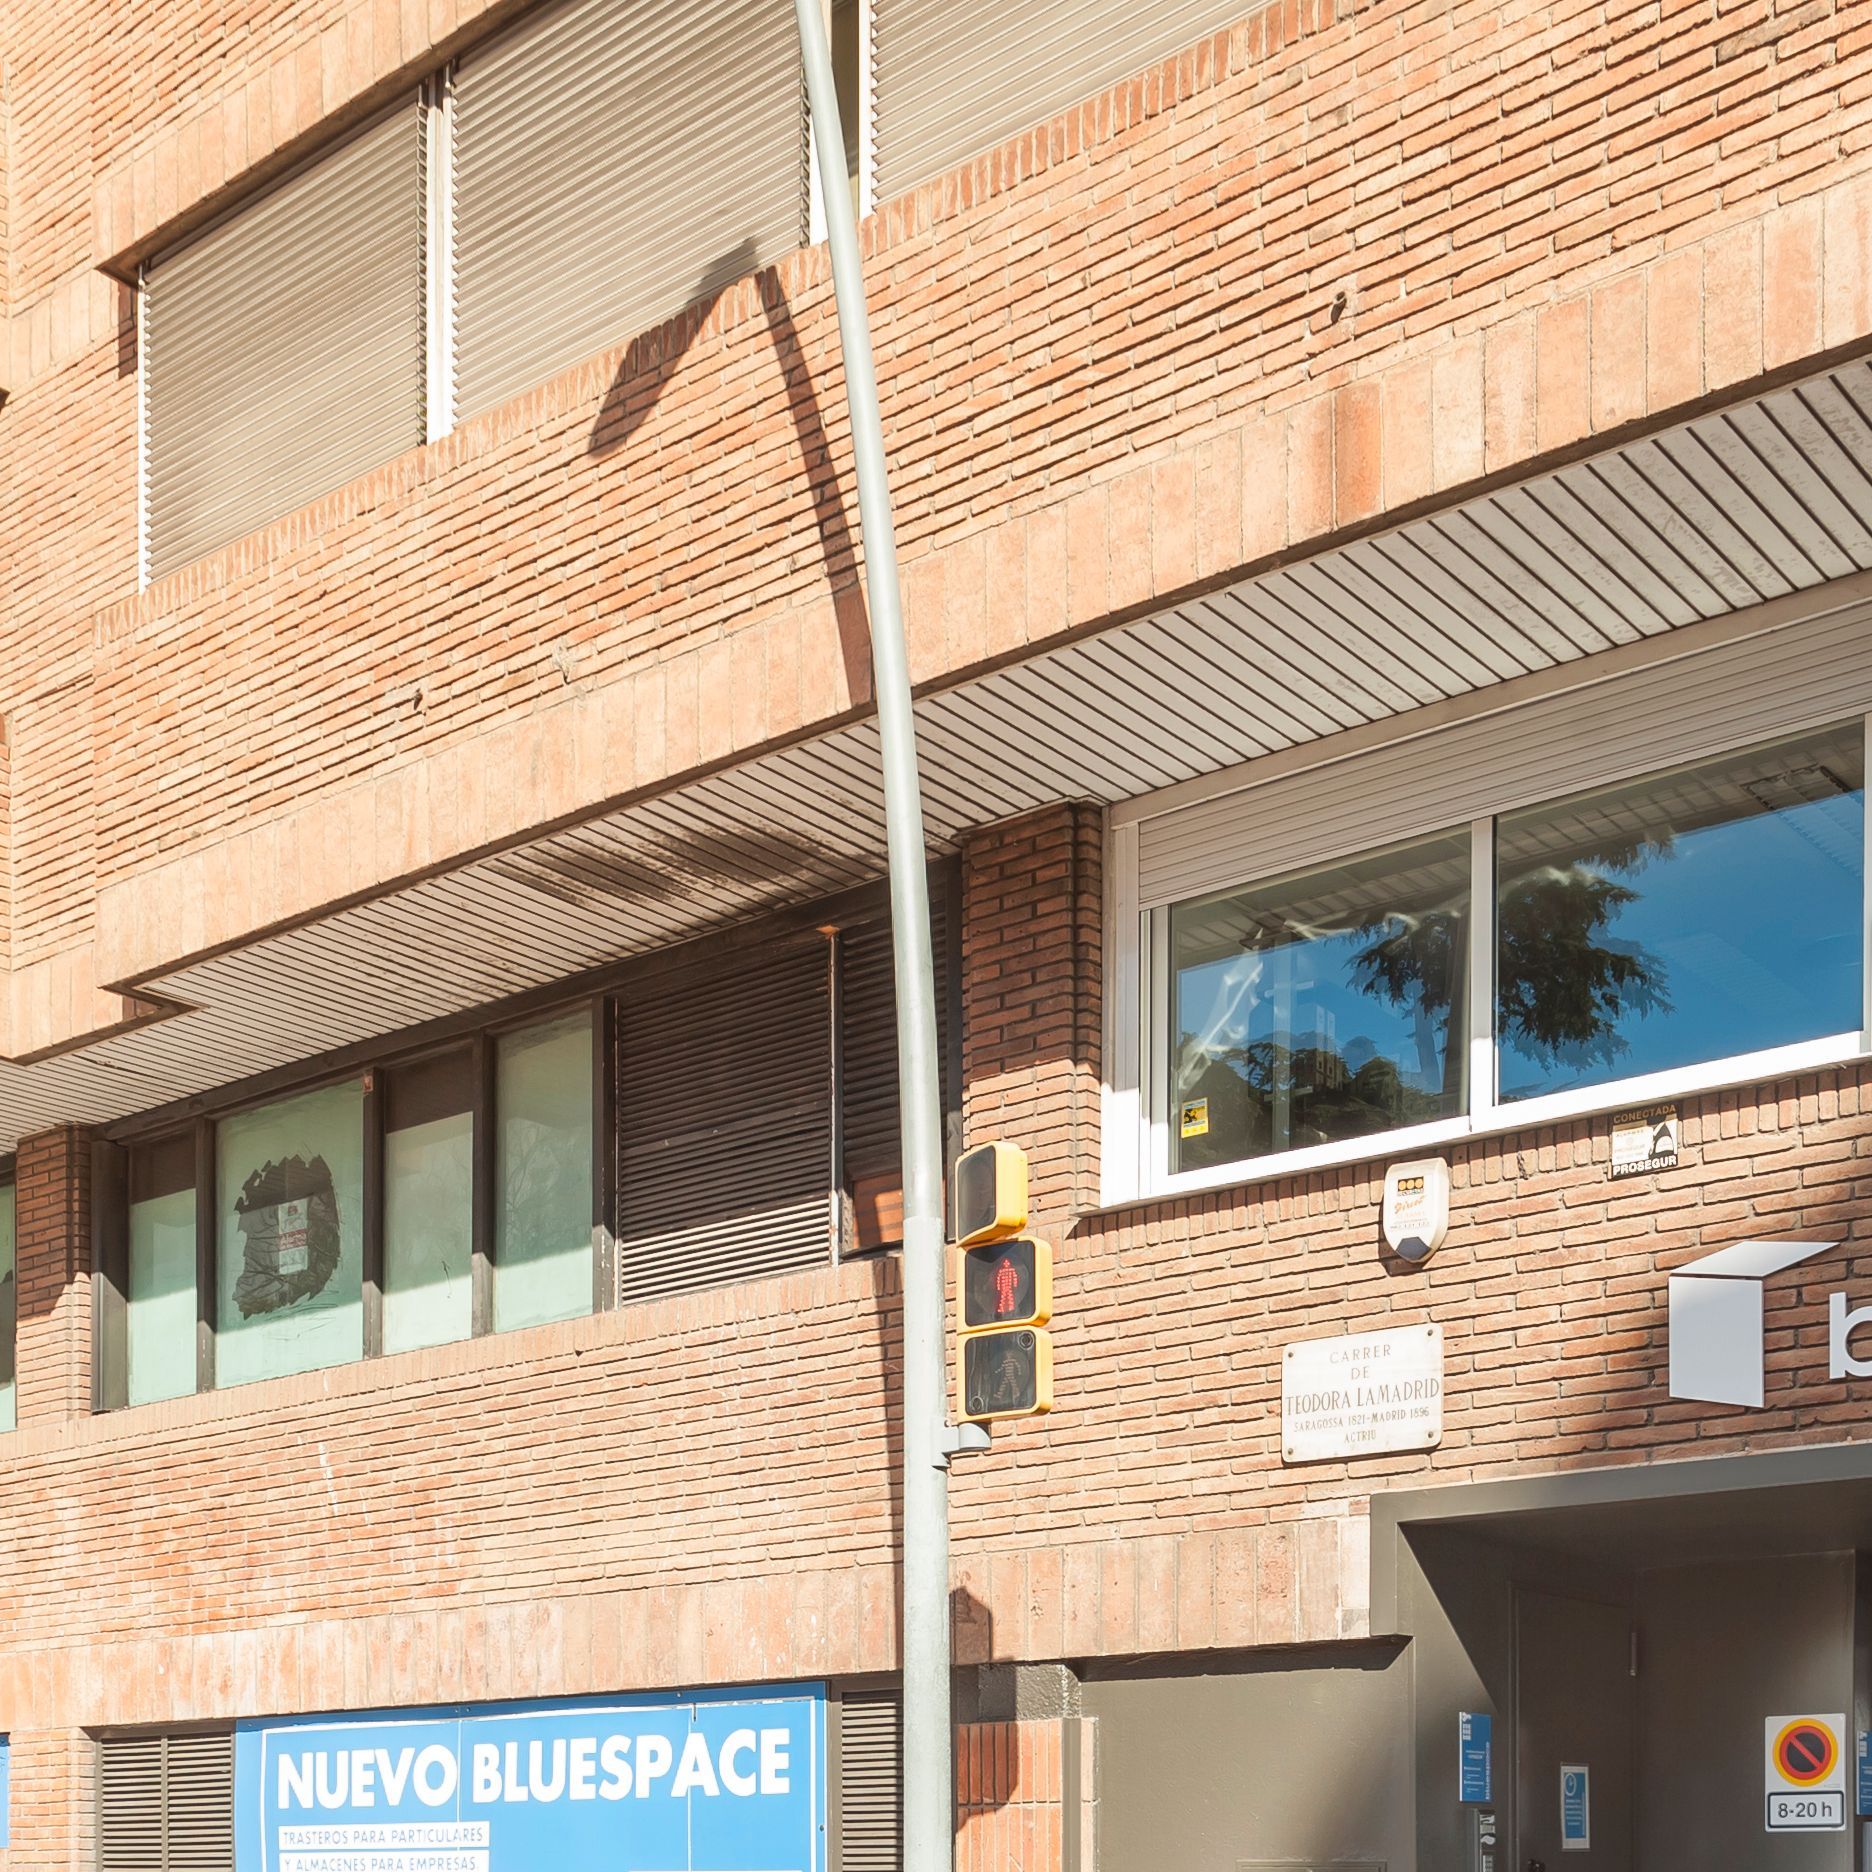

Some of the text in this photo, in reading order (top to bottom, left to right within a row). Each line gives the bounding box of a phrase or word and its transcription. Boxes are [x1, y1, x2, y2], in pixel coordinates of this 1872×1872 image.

[1613, 1104, 1676, 1123] CONECTADA
[1613, 1155, 1677, 1176] PROSEGUR
[1329, 1344, 1391, 1364] CARRER
[1351, 1366, 1370, 1380] DE
[1285, 1378, 1440, 1416] TEODORA LAMADRID
[1294, 1417, 1344, 1432] SARAGOSSA
[1344, 1430, 1376, 1444] ACTRIU
[278, 1728, 790, 1809] NUEVO BLUESPACE
[1778, 1802, 1833, 1819] 8-20 h
[283, 1827, 483, 1845] TRASTEROS PARA PARTICULARES
[285, 1860, 291, 1872] Y
[296, 1858, 366, 1872] ALMACENES
[371, 1858, 403, 1872] PARA
